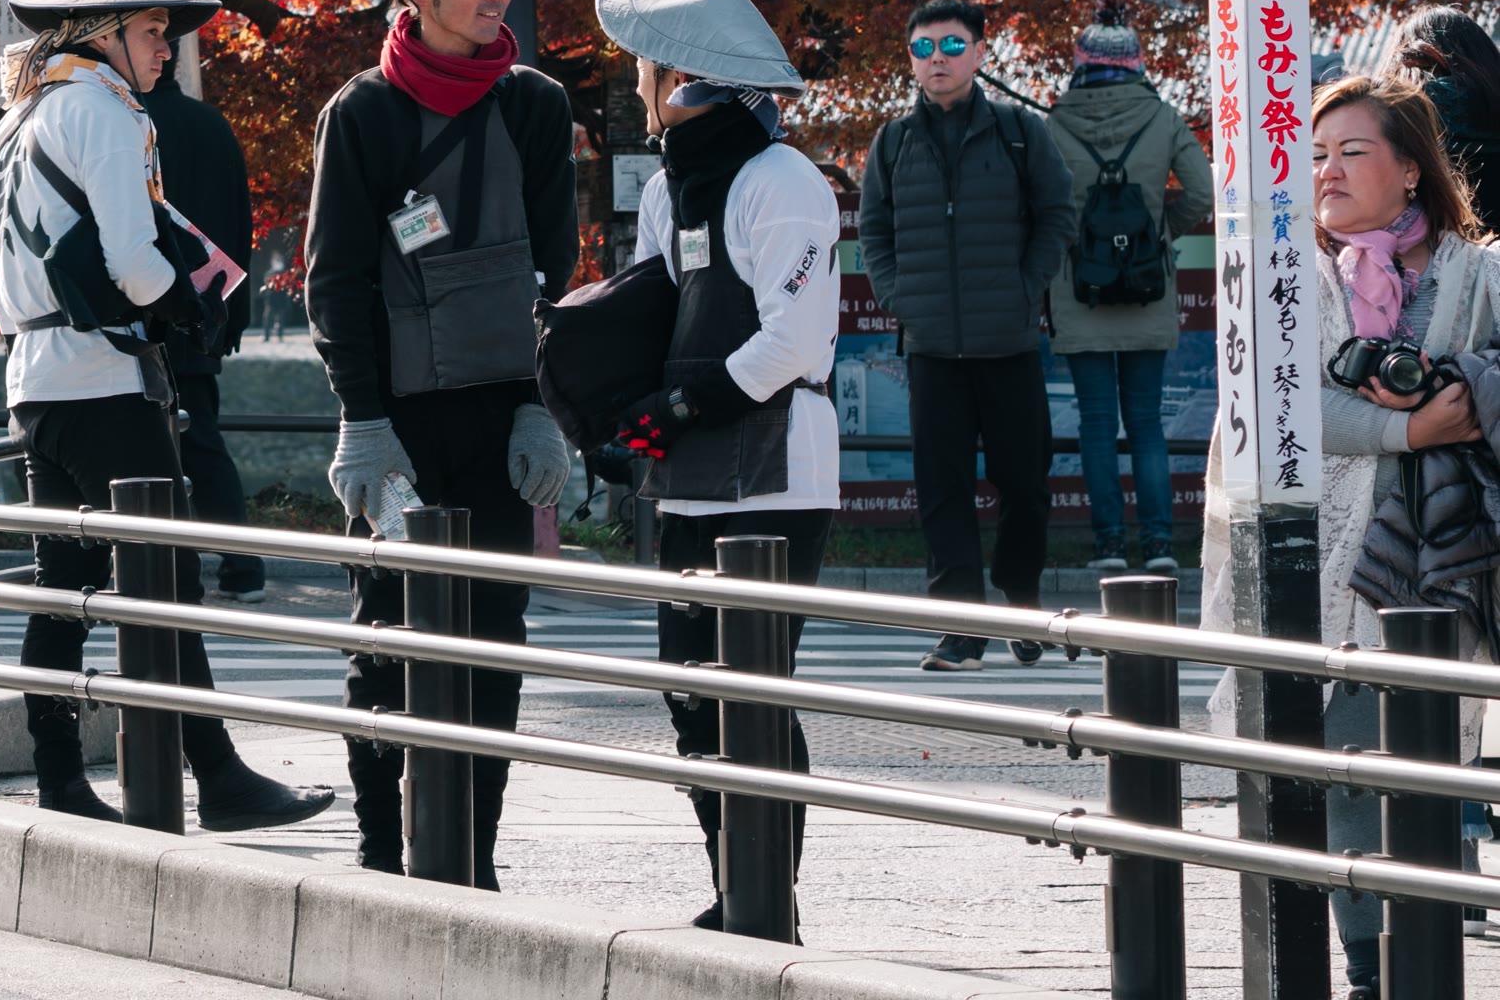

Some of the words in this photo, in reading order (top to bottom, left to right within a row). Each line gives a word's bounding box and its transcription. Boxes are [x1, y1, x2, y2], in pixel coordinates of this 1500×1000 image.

[1257, 0, 1303, 186] もみじ祭り
[1269, 189, 1293, 245] 協賛
[1267, 247, 1302, 270] 本家
[858, 317, 899, 331] 環境に
[1268, 272, 1303, 358] 桜もち
[1222, 249, 1248, 457] 竹むら
[843, 376, 860, 435] 渡月
